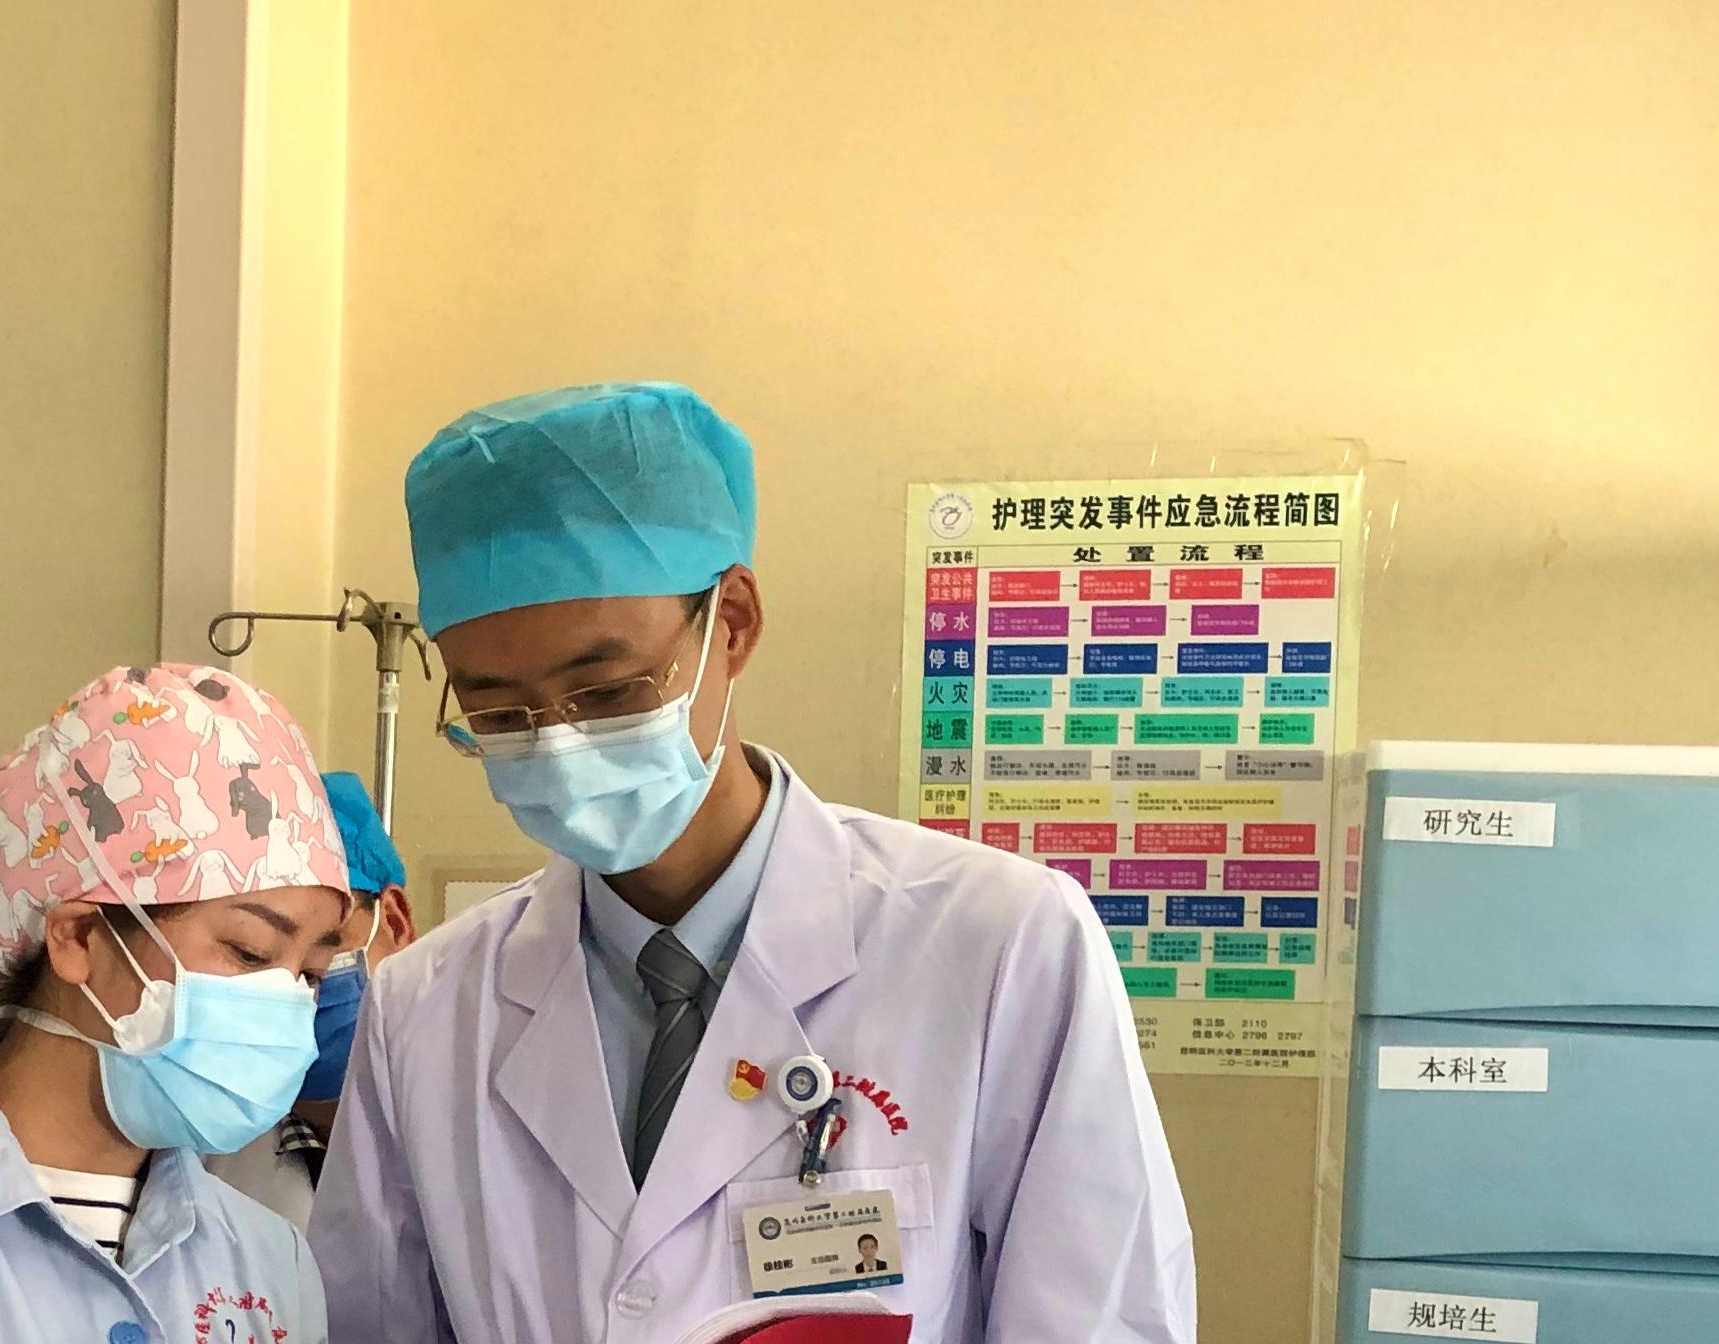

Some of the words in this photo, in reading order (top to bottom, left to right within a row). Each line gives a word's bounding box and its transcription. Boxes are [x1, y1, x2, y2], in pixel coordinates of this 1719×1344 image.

[992, 492, 1340, 531] 护理突发事件应急流程简图
[932, 550, 973, 564] 突发事件
[1073, 545, 1264, 562] 处置流程
[930, 611, 970, 632] 停水
[929, 648, 970, 669] 停电
[928, 681, 968, 704] 火灾
[927, 718, 968, 741] 地震
[924, 789, 967, 802] 医疗护理
[1423, 808, 1515, 838] 研究生
[1138, 1029, 1158, 1038] 274
[1242, 1020, 1267, 1028] 2110
[1417, 1055, 1508, 1084] 本科室
[1406, 1301, 1498, 1334] 规培生
